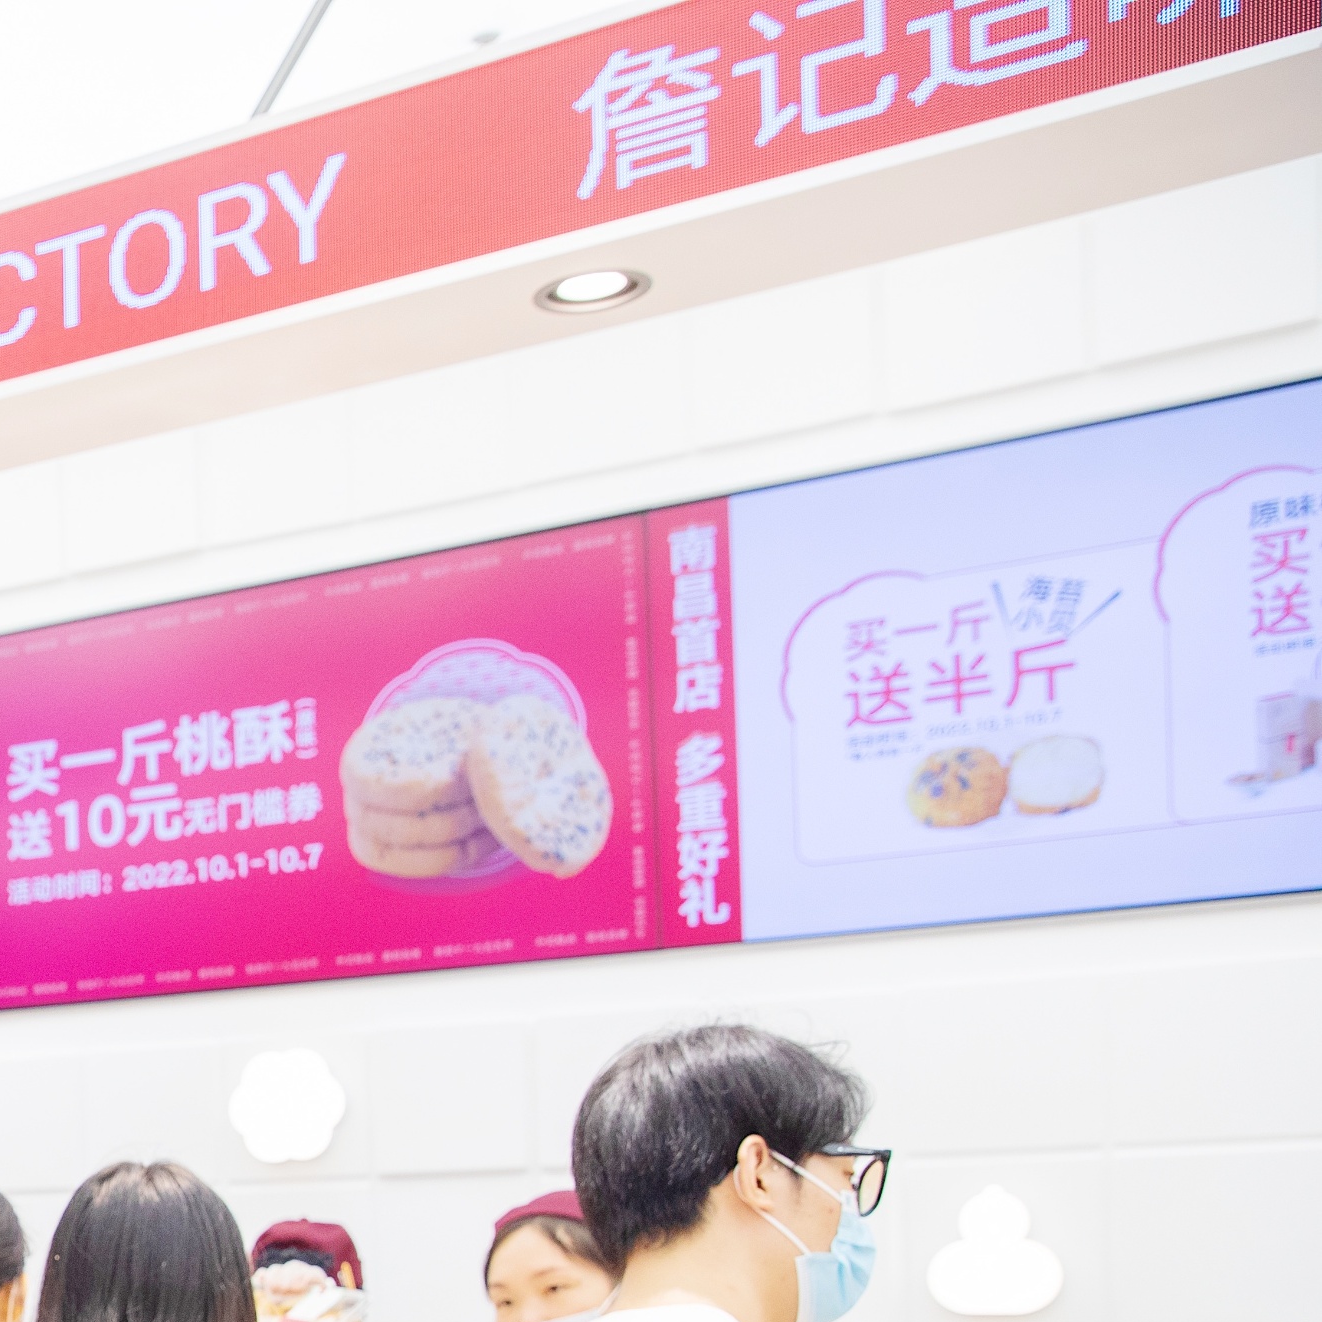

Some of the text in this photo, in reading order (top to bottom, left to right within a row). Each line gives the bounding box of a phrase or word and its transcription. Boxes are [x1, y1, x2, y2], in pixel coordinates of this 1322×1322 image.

[845, 599, 991, 663] 买一斤
[668, 524, 731, 928] 南昌首店 多重好礼
[846, 637, 1077, 728] 送半斤
[6, 700, 294, 802] 买一斤桃酥
[7, 782, 323, 862] 送10元无门槛券
